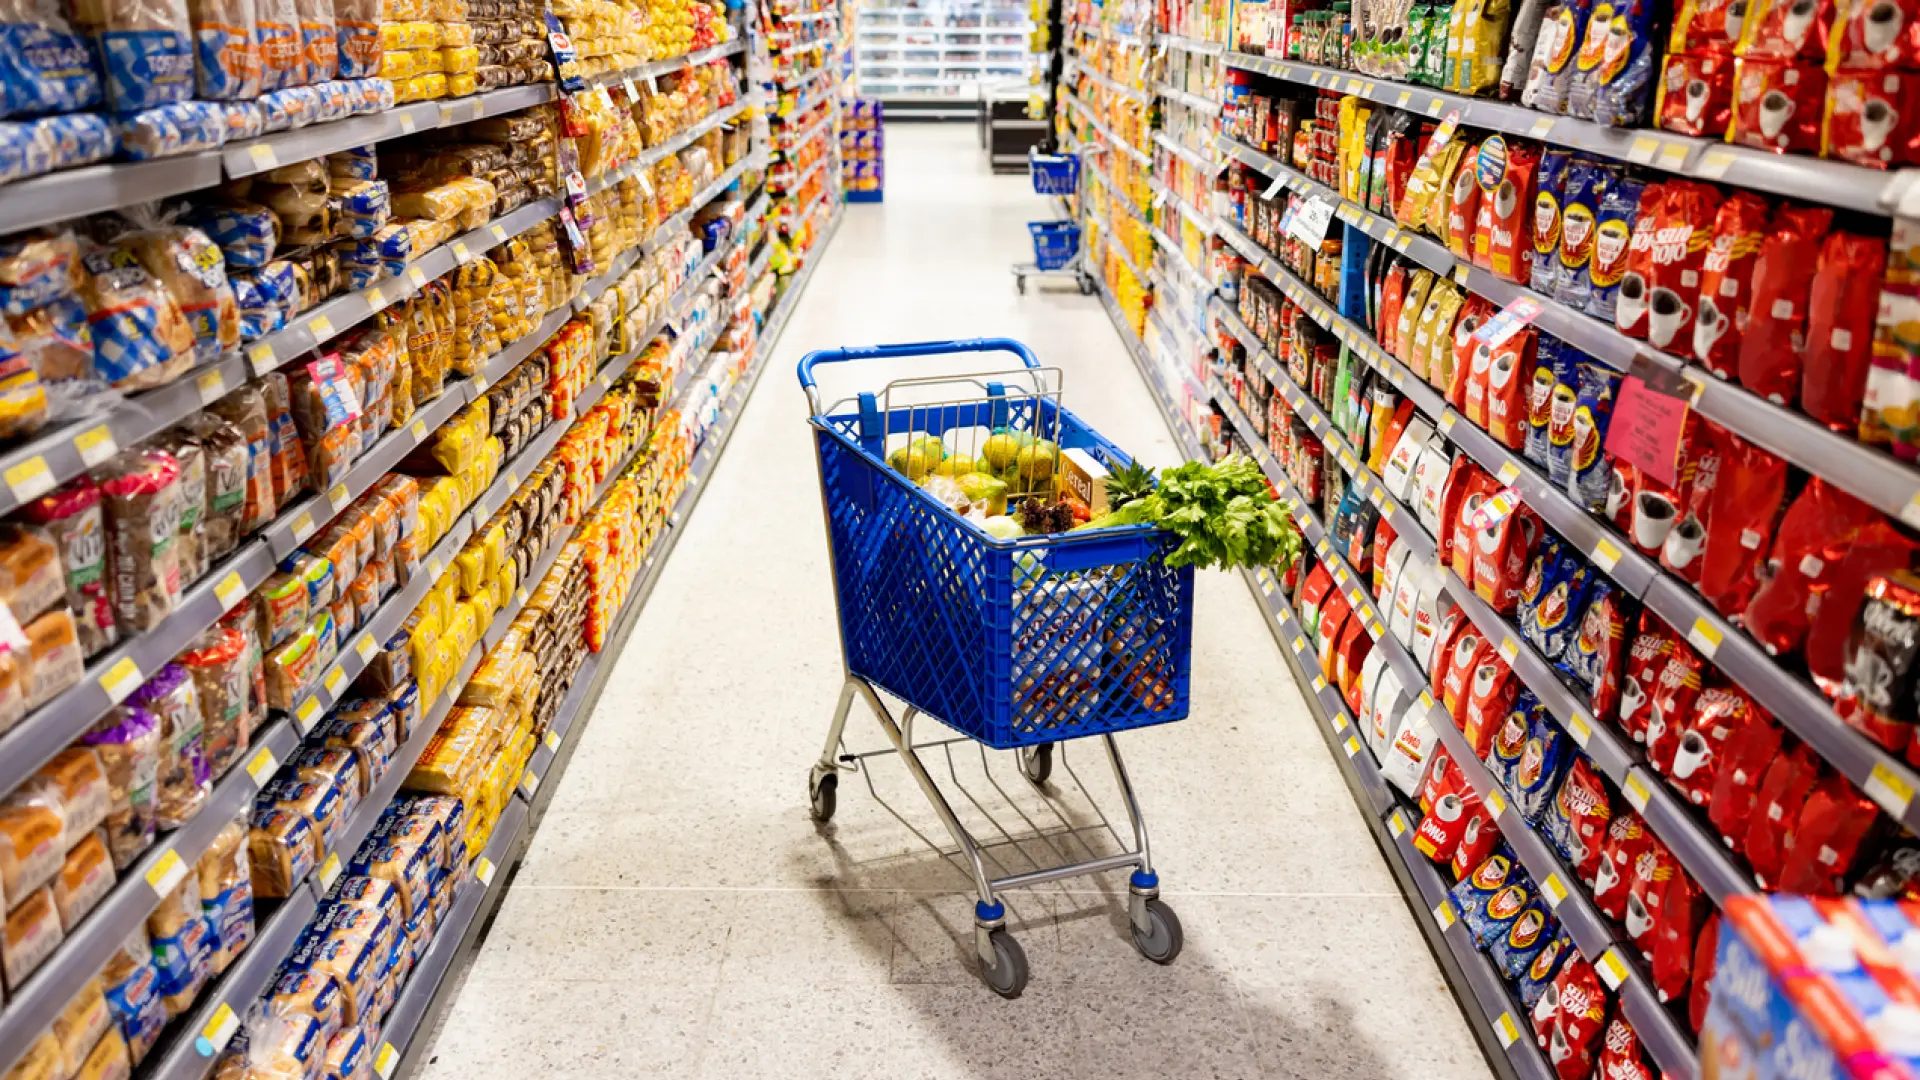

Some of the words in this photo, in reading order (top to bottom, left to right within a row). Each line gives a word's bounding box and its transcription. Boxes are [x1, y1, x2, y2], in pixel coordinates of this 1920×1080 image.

[1061, 461, 1091, 503] Cereal
[1401, 729, 1421, 750] Oma
[1421, 818, 1447, 845] Oma
